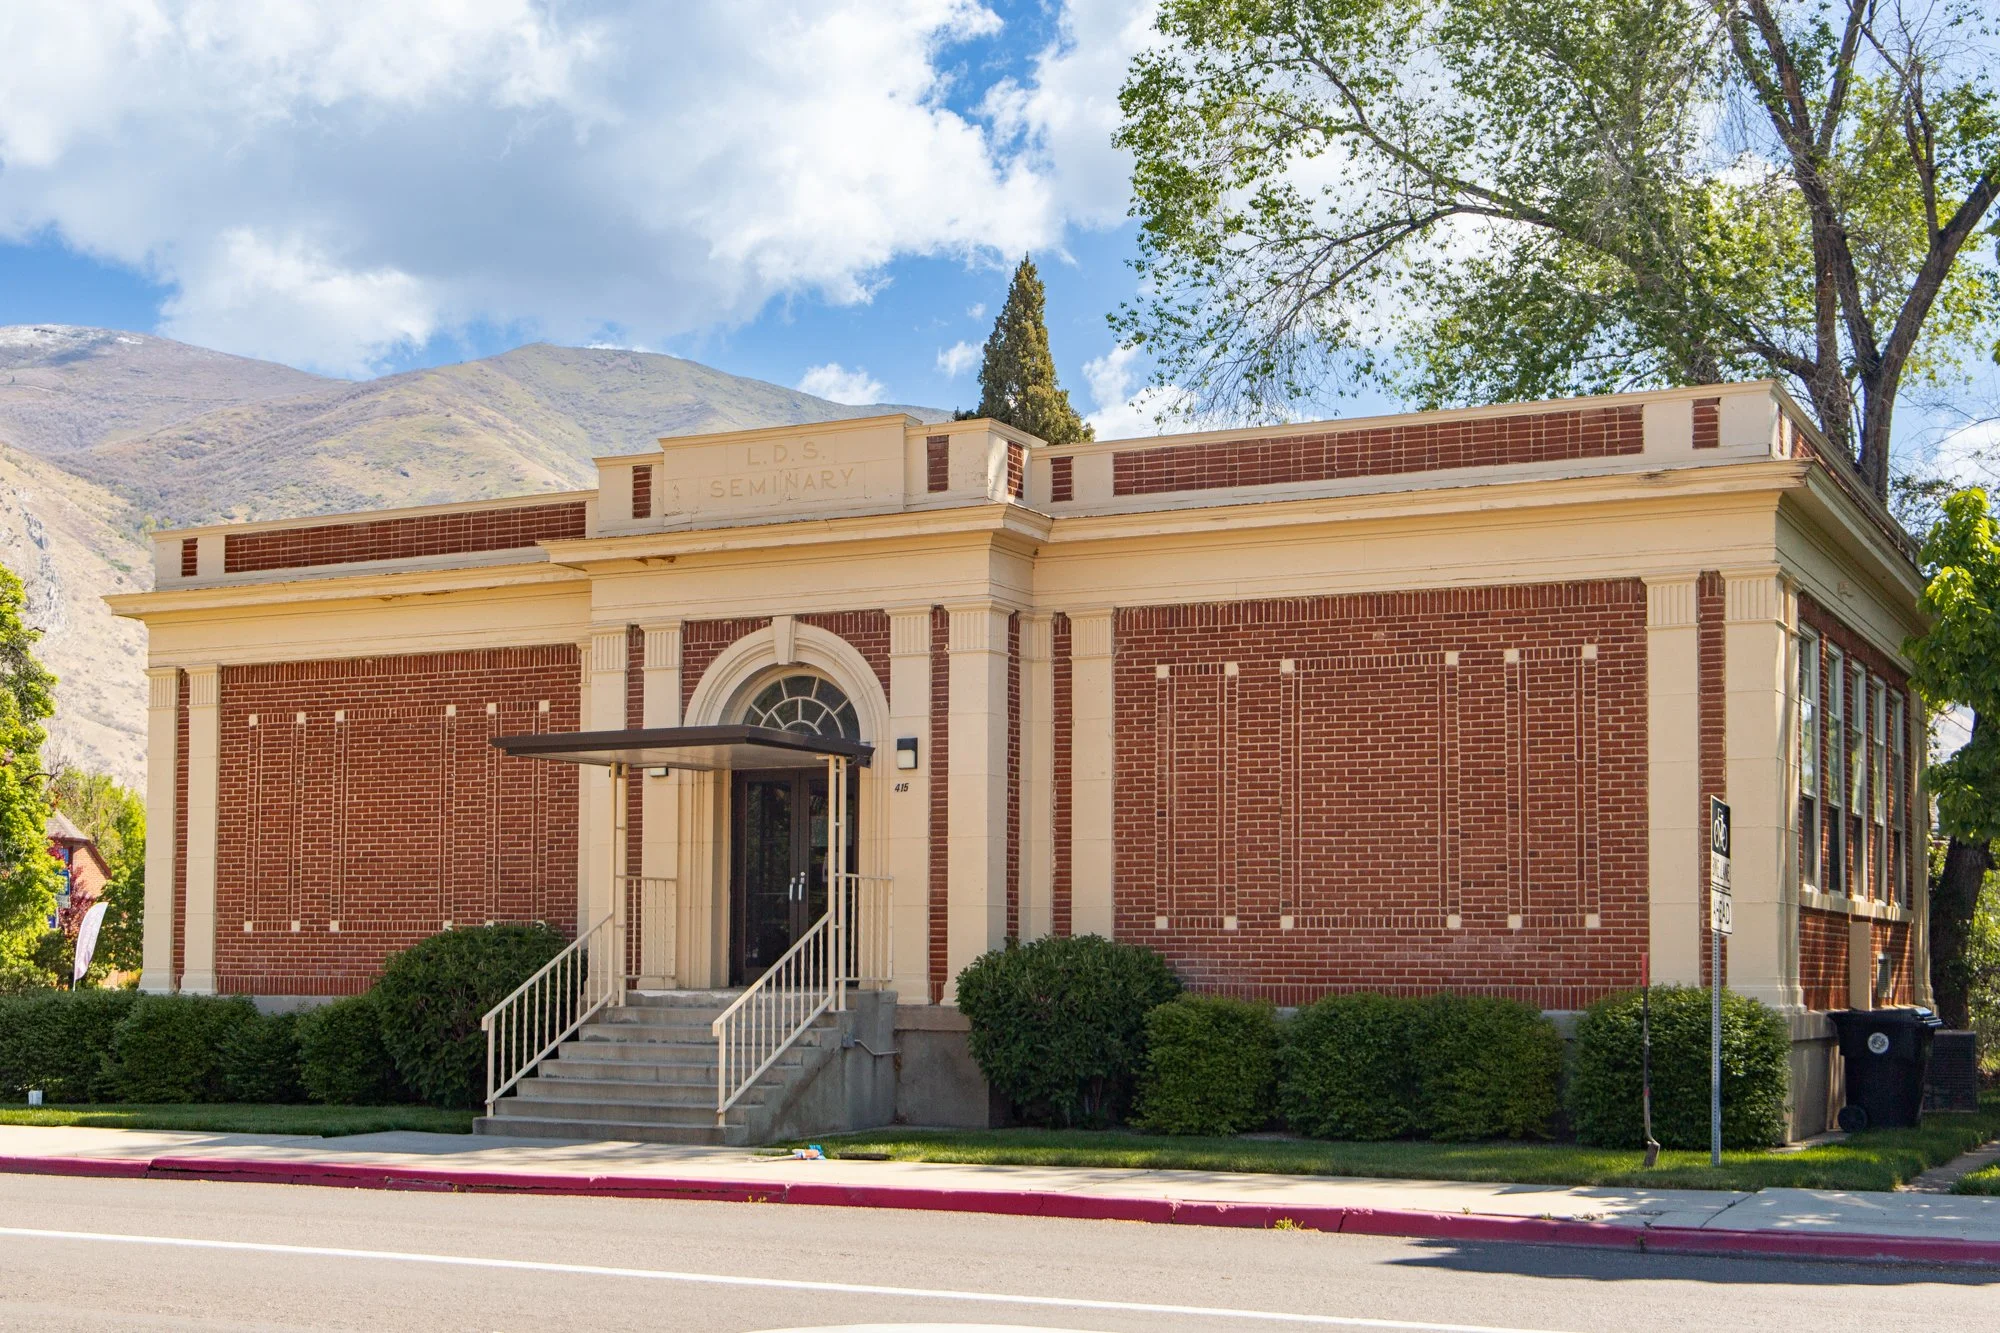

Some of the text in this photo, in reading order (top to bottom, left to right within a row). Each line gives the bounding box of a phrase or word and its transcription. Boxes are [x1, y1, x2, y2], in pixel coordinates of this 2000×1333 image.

[710, 467, 855, 499] SEMINARY
[894, 782, 909, 793] 415
[1713, 899, 1731, 925] AHEAD
